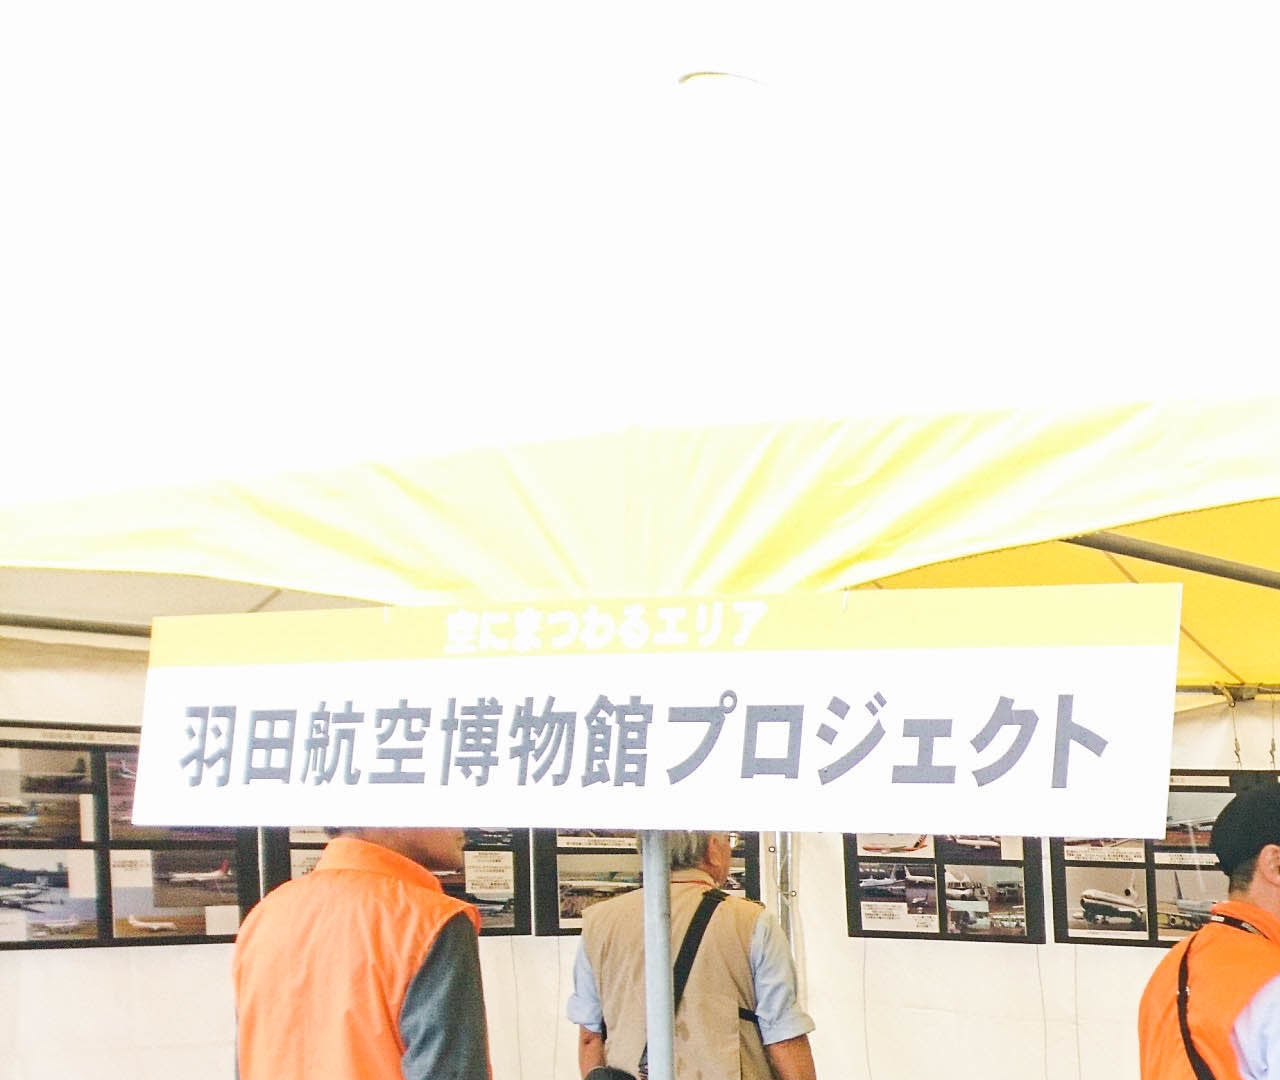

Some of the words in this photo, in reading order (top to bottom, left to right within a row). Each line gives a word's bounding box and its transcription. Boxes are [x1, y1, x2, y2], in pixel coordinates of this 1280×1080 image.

[443, 600, 769, 654] 空にまつわるエリア
[178, 688, 1110, 789] 羽田航空博物館プロジェクト
